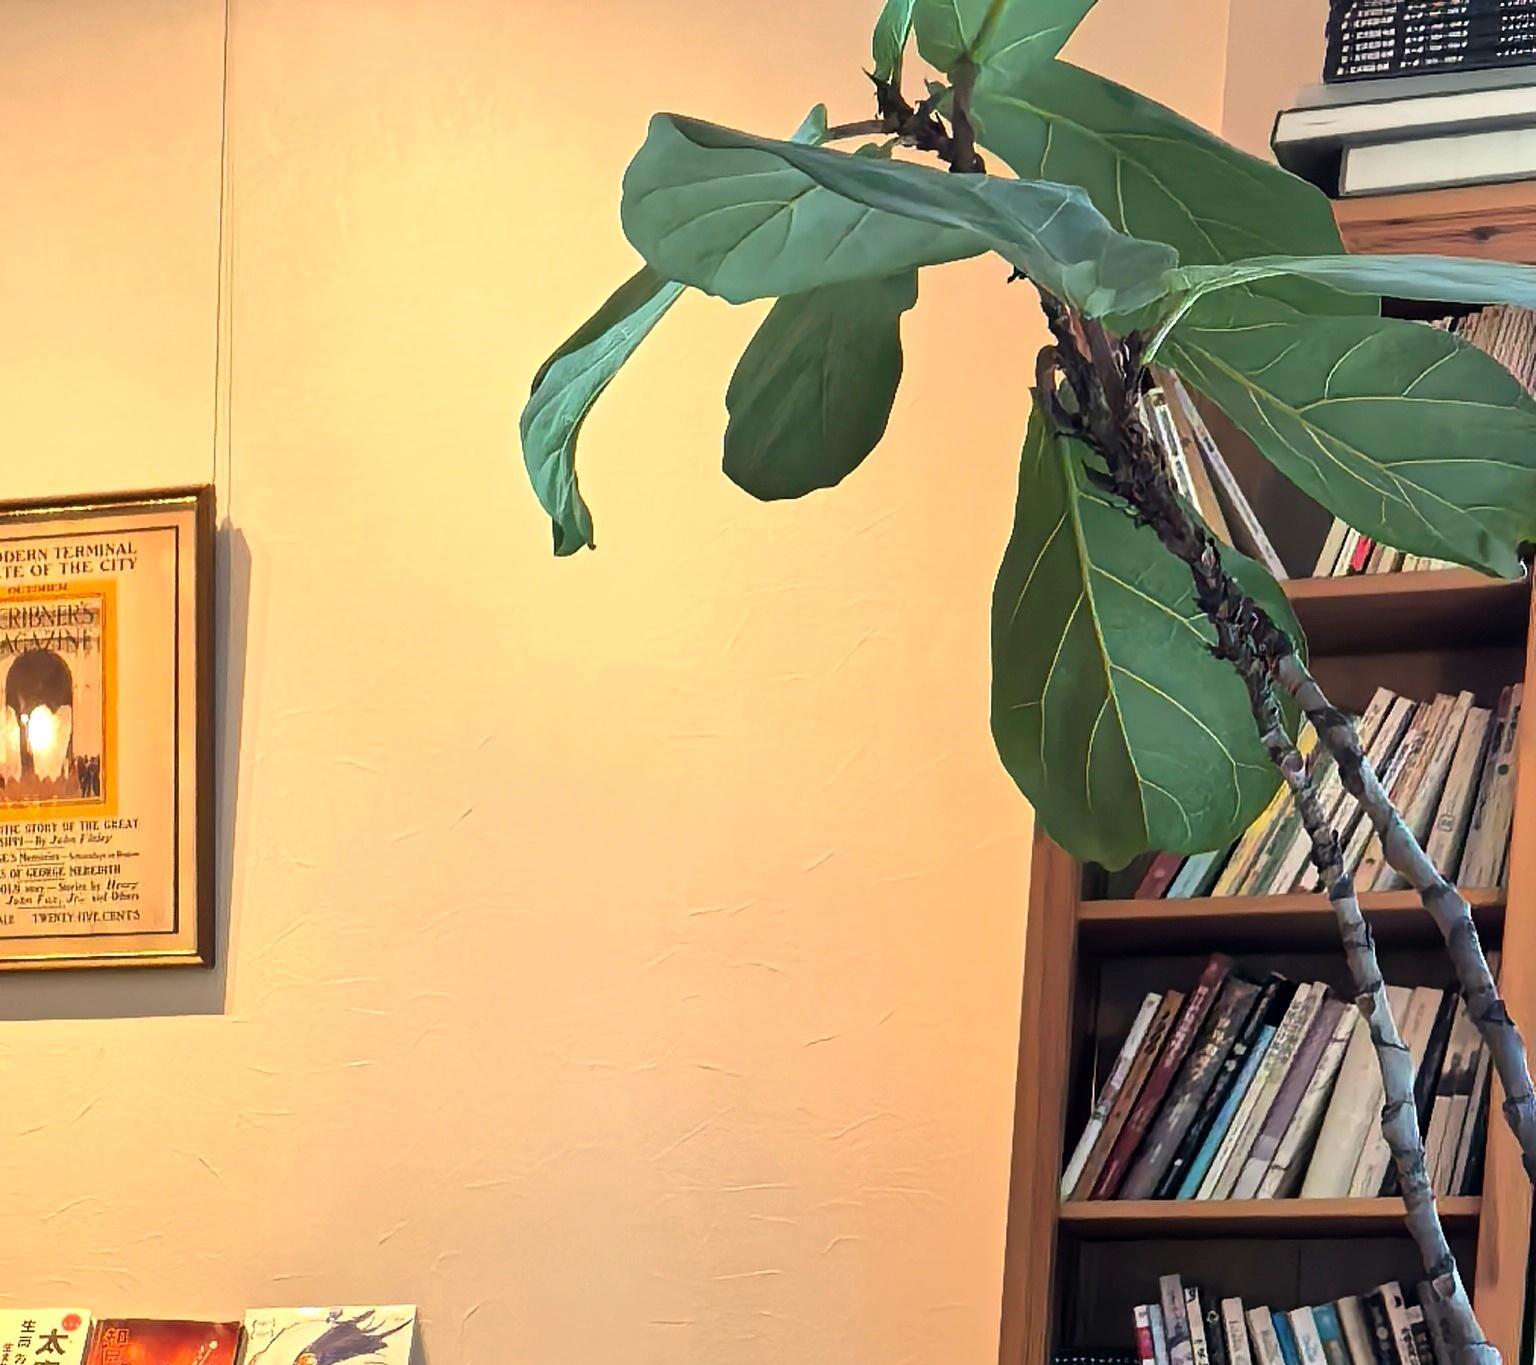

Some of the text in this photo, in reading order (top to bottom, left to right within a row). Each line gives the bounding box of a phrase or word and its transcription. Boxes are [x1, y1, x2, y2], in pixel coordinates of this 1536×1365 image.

[53, 541, 138, 560] TERMINAL
[30, 563, 50, 577] OF
[58, 560, 93, 575] THE
[99, 556, 138, 572] CITY
[103, 818, 139, 830] GREAT
